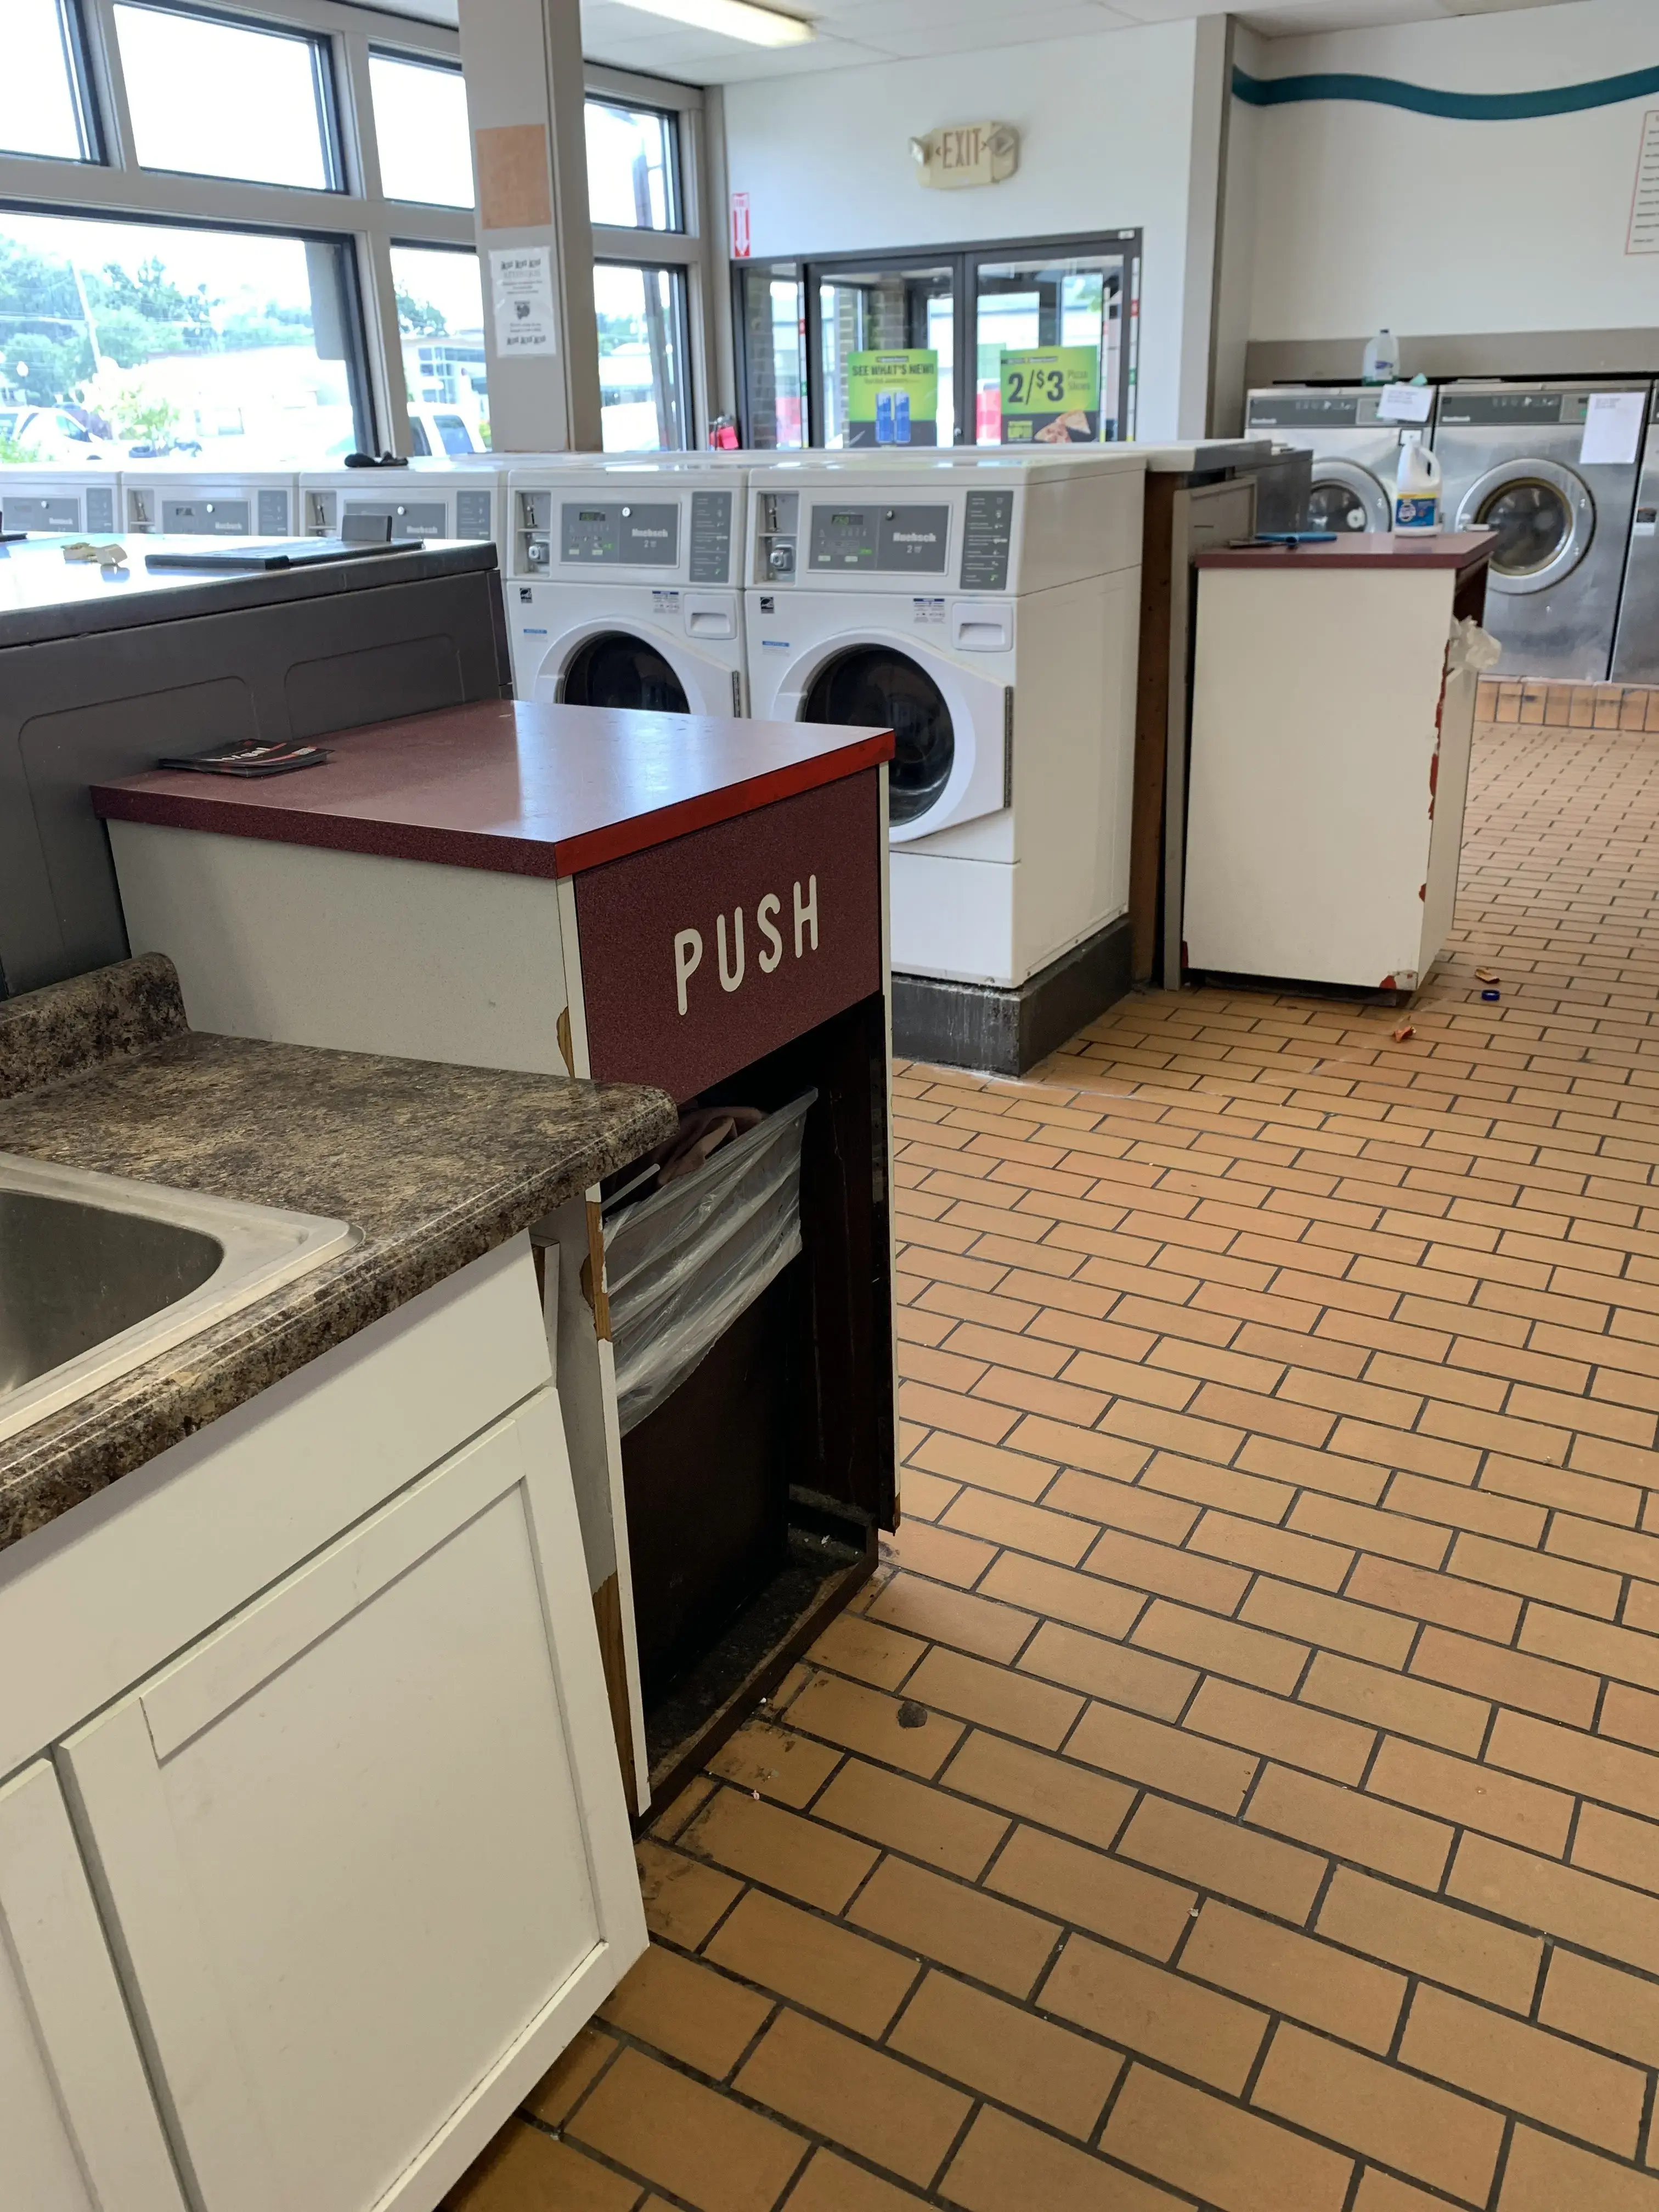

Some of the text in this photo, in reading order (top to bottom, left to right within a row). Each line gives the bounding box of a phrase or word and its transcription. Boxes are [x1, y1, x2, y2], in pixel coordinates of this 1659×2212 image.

[943, 127, 981, 170] EXIT
[852, 365, 868, 376] SEE
[871, 364, 907, 375] WHAT'S
[1008, 369, 1064, 405] 2/$3
[674, 874, 819, 1015] PUSH
